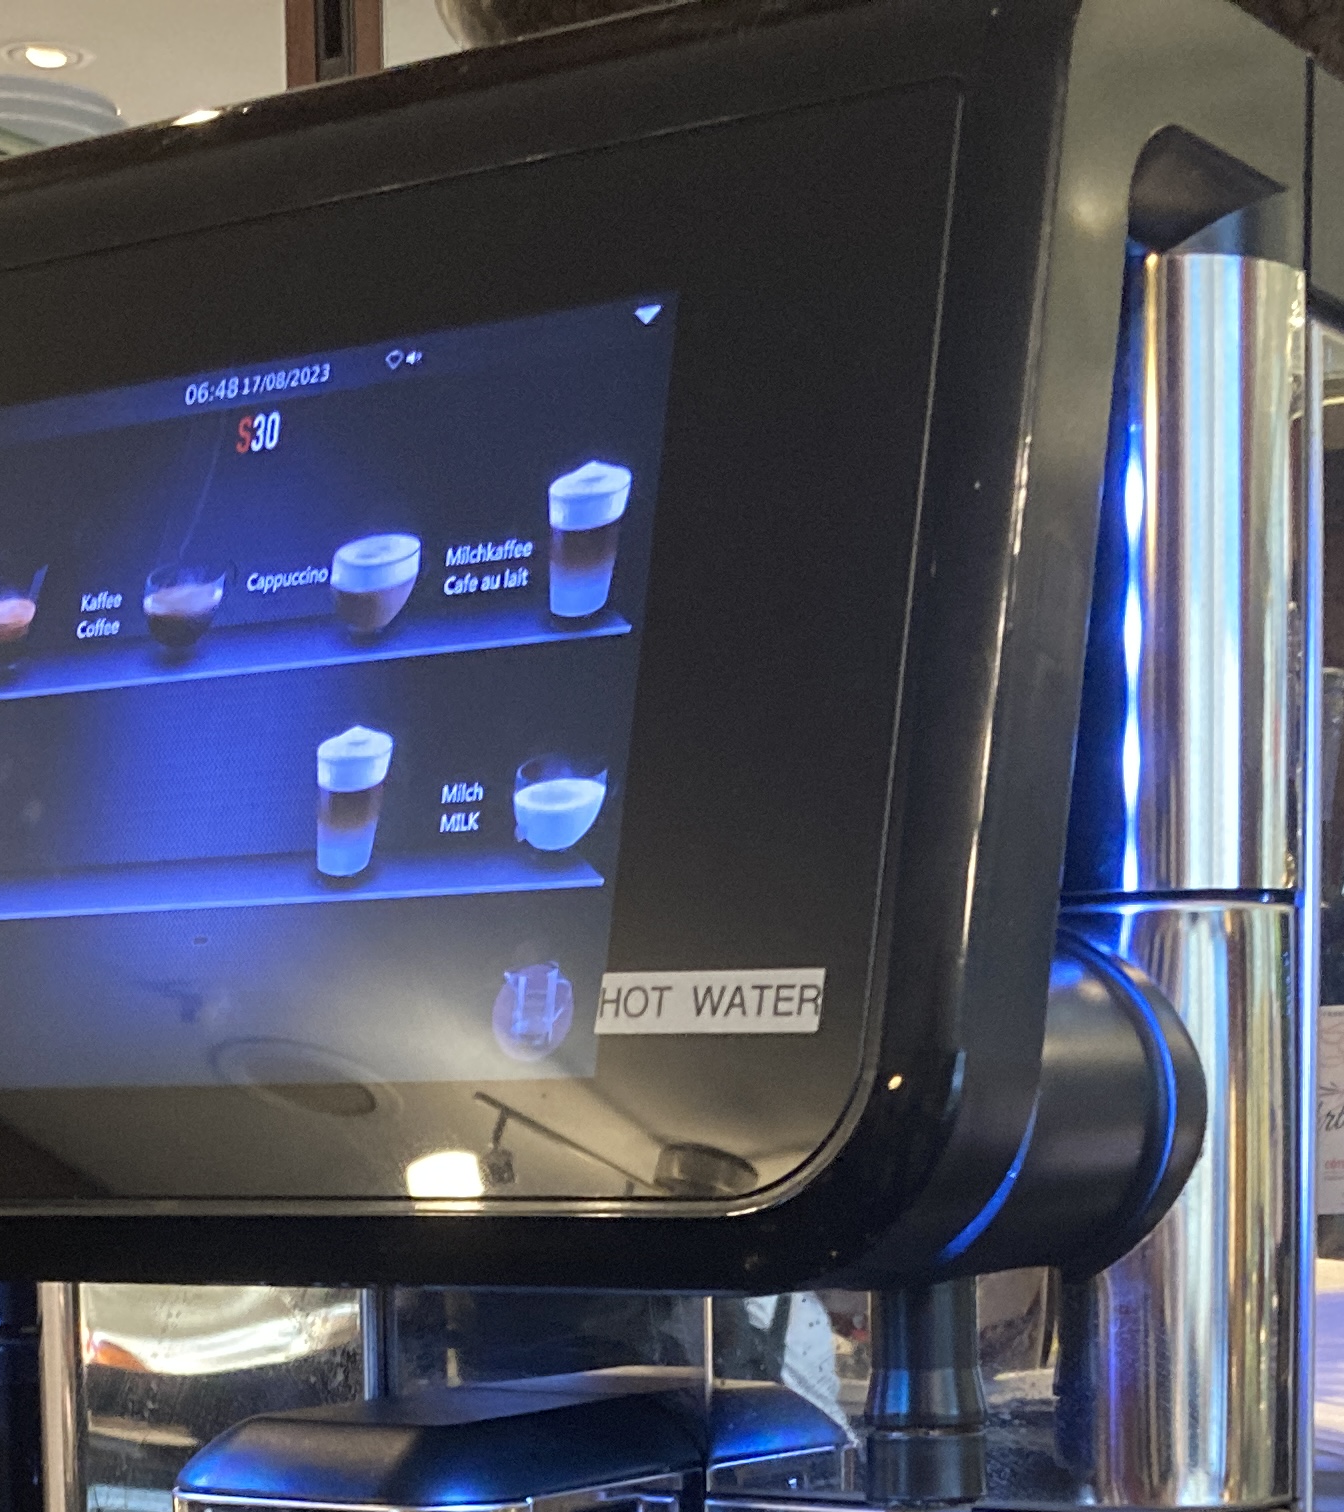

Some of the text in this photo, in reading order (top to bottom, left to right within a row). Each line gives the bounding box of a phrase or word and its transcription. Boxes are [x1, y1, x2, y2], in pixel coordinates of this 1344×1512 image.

[185, 363, 331, 405] 06:48 17/08/2023
[236, 410, 281, 454] S30
[445, 538, 534, 566] Milchkaffee
[246, 566, 330, 595] Cappuccino
[480, 572, 501, 591] au
[503, 567, 529, 588] lait
[80, 591, 123, 613] Kaffee
[76, 617, 121, 639] Coffee
[441, 781, 483, 804] Milch
[440, 811, 480, 834] MILK
[598, 984, 822, 1019] HOT WATER
